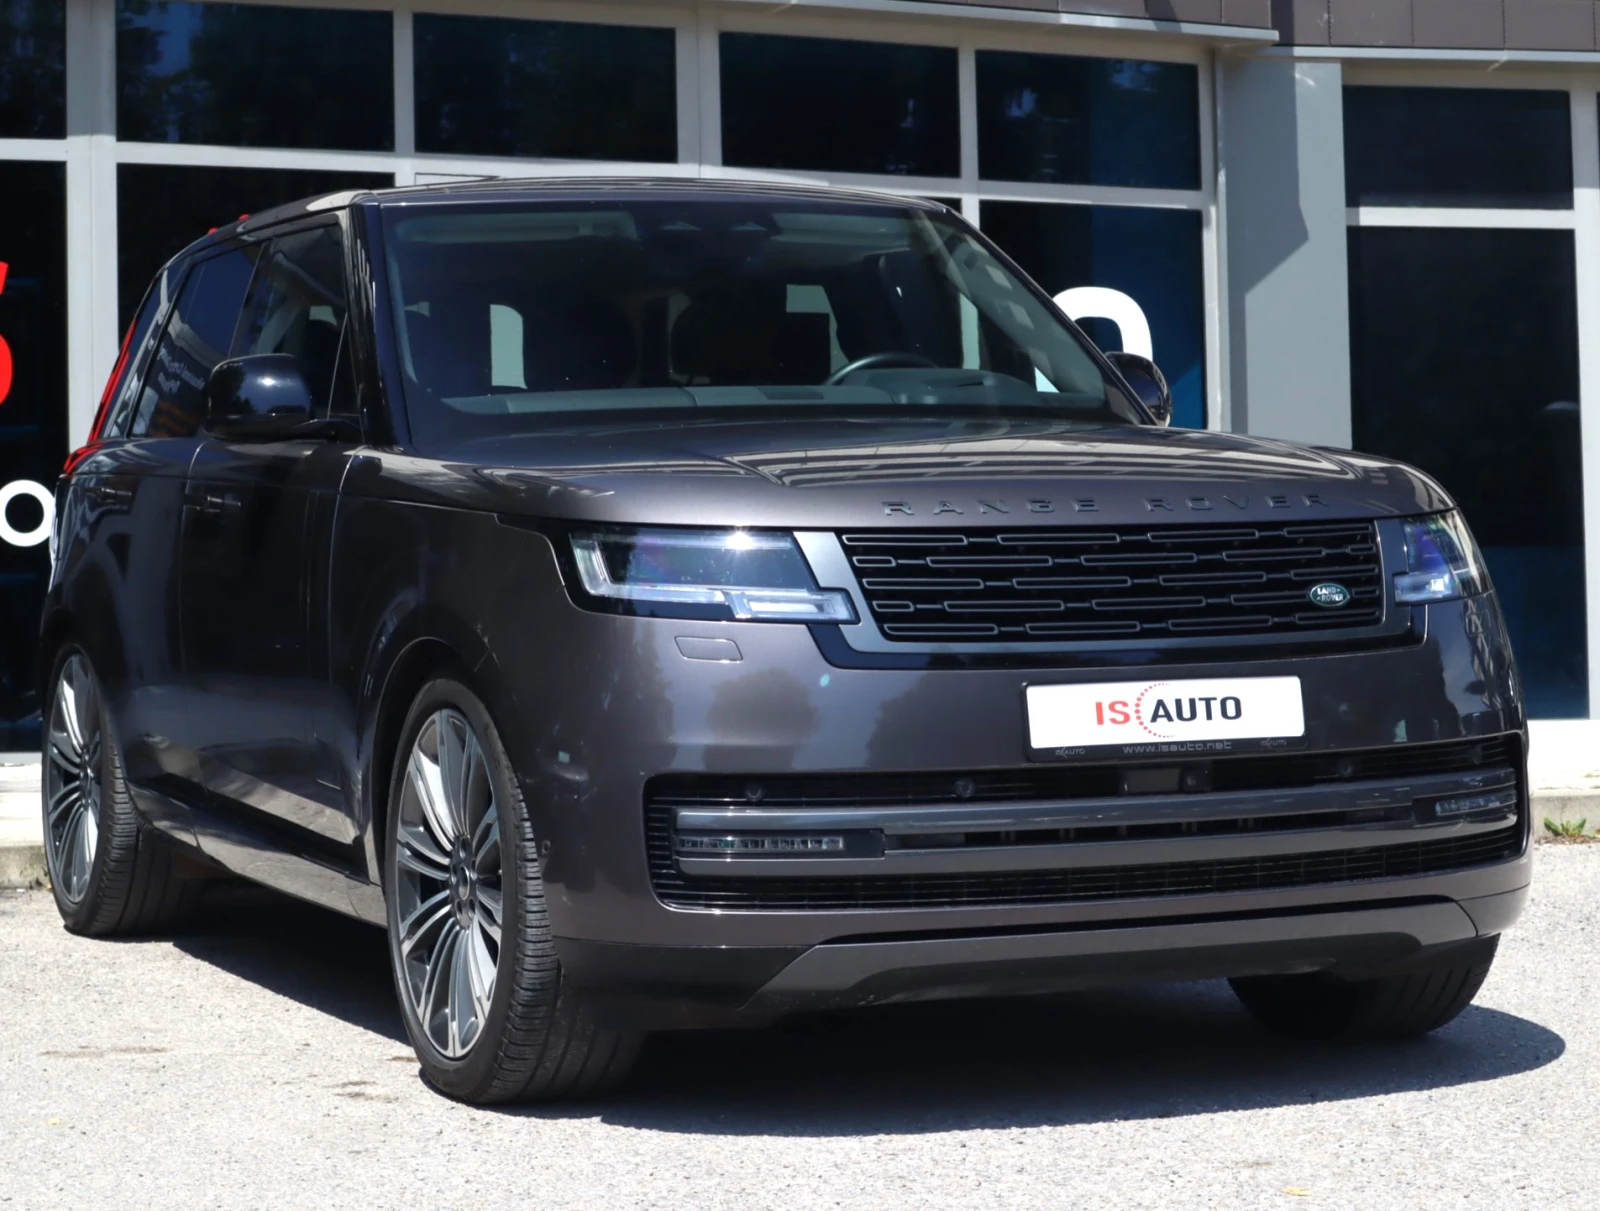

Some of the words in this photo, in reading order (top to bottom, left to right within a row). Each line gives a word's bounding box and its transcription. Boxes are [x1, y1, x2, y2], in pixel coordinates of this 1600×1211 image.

[881, 499, 1099, 516] RANGE
[1143, 491, 1329, 512] ROVER
[1316, 587, 1337, 595] LAND
[1095, 700, 1131, 726] IS
[1149, 696, 1243, 723] AUTO
[1122, 739, 1233, 754] www.isauto.net
